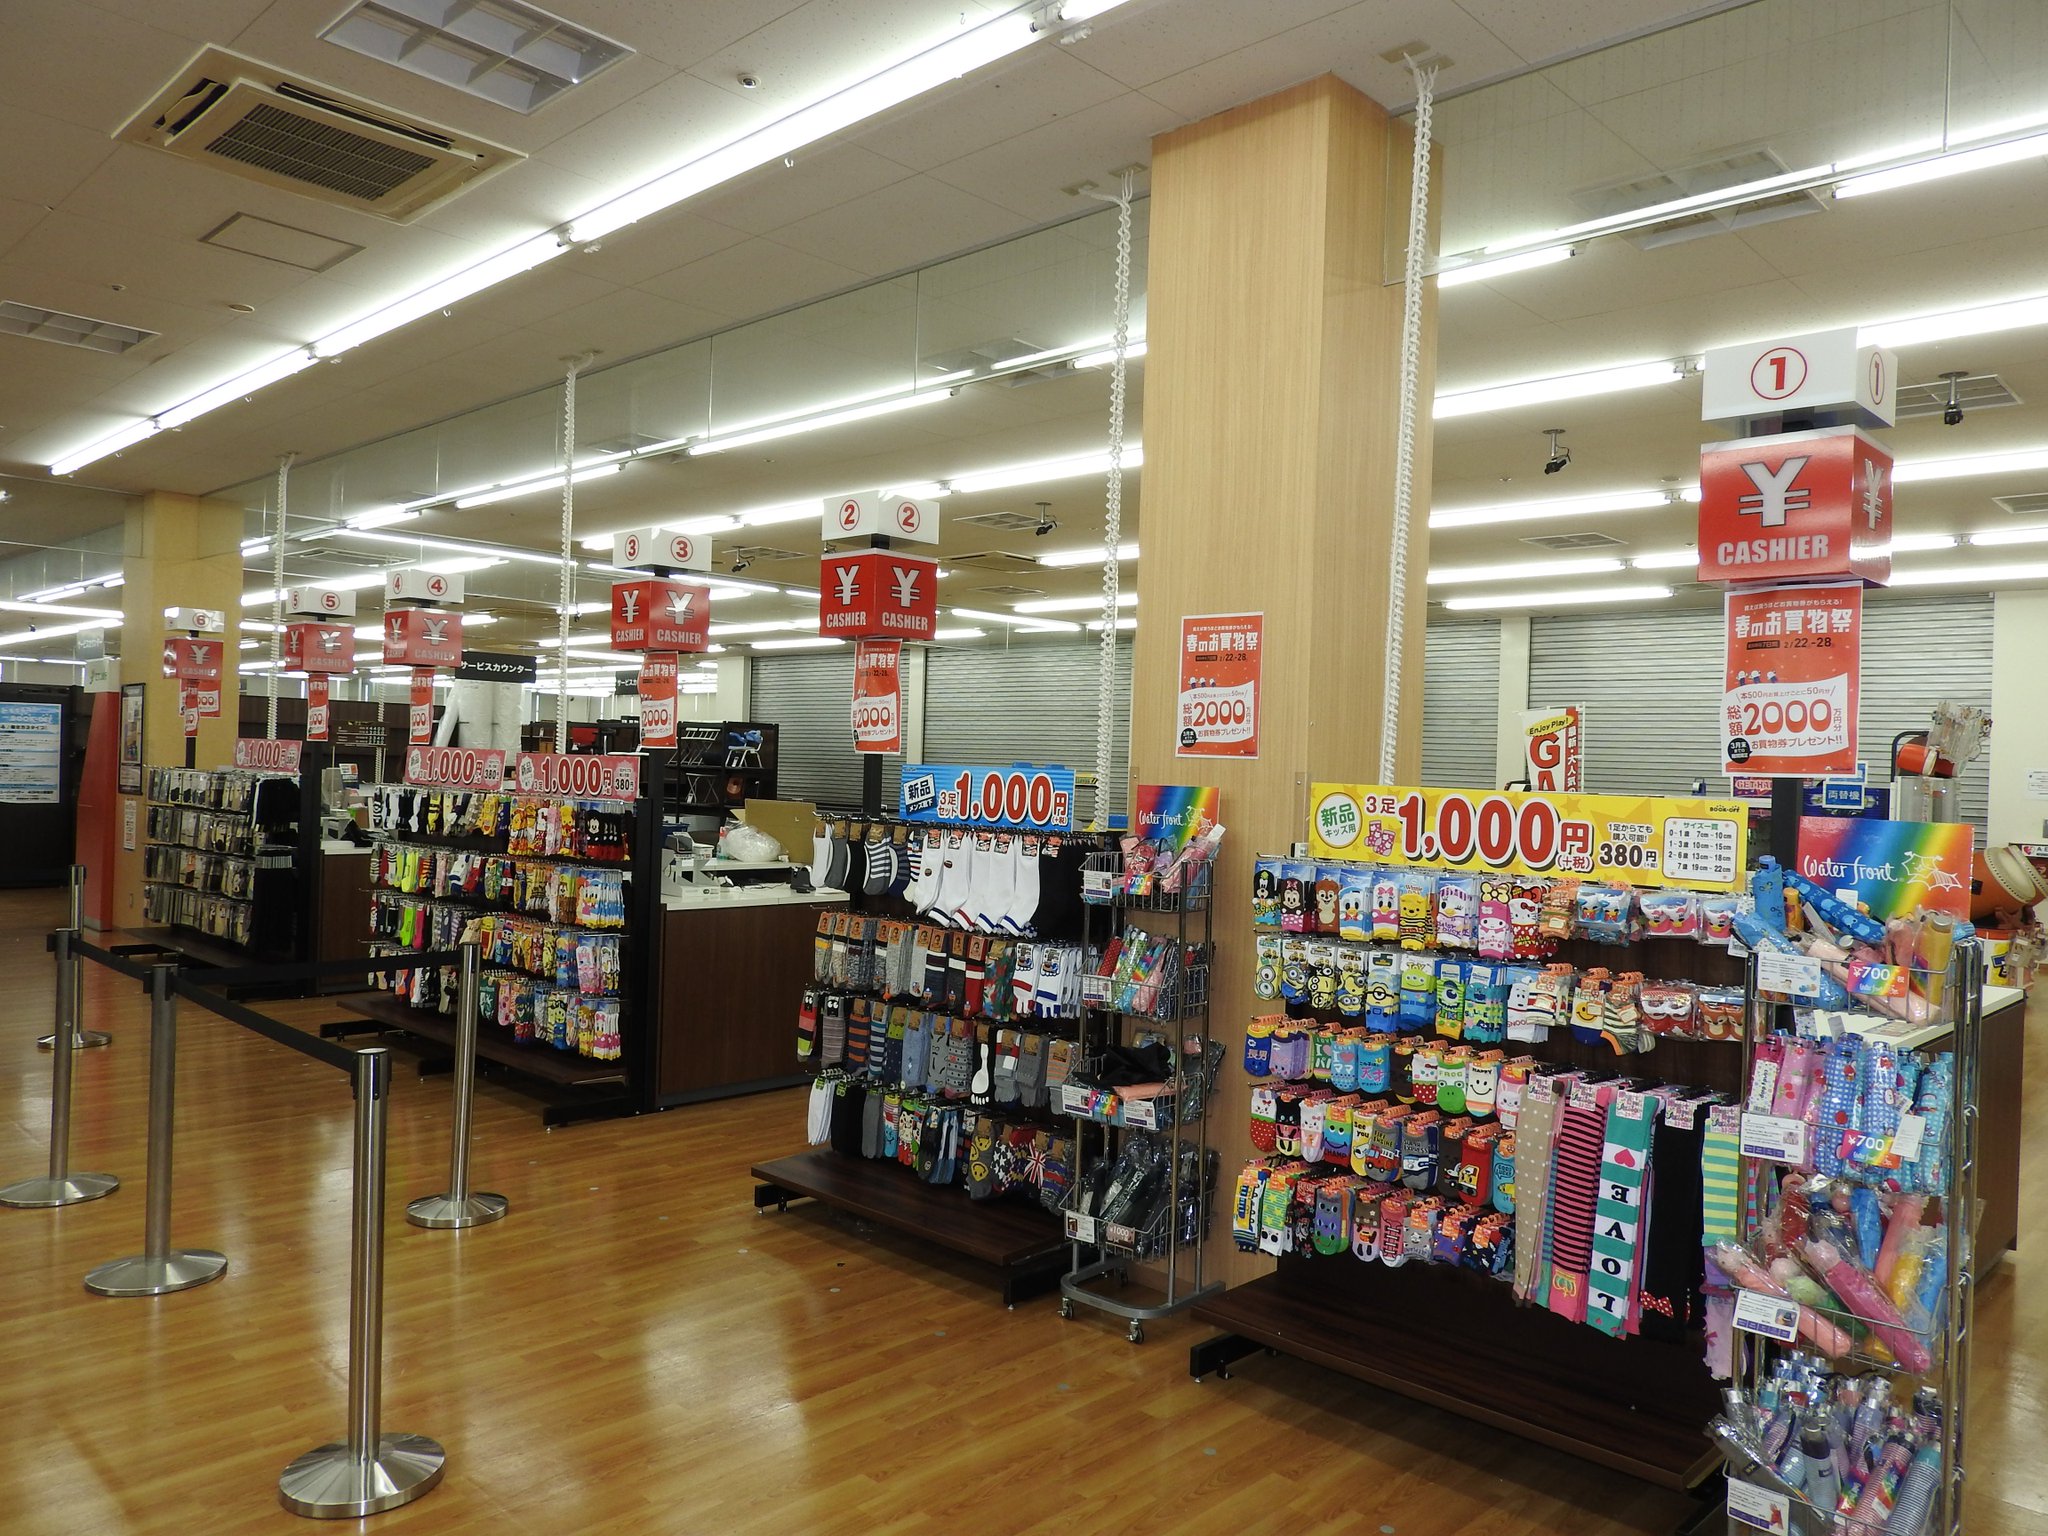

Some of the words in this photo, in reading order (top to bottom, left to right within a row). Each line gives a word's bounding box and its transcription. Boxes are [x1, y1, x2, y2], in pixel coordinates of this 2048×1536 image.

[1717, 534, 1829, 566] CASHIER
[826, 611, 867, 629] CASHIER
[882, 611, 928, 631] CASHIER
[1735, 608, 1853, 639] 春のお買物祭
[616, 628, 644, 643] CASHIER
[656, 629, 701, 645] CASHIER
[1186, 631, 1258, 652] 春のお買物祭
[461, 660, 533, 674] サービスカウンター
[857, 706, 890, 729] 2000
[1193, 699, 1245, 727] 2000
[1743, 699, 1832, 736] 2000
[1529, 724, 1551, 735] Enjoy
[908, 779, 931, 801] 新品
[940, 791, 957, 806] 3足
[1828, 789, 1860, 801] 両替機
[938, 806, 957, 818] セット
[1366, 795, 1395, 814] 3足
[1139, 809, 1161, 826] Water
[1320, 803, 1356, 829] 新品
[1325, 823, 1356, 838] キッズ用
[1608, 823, 1653, 834] 1足からでも
[1804, 854, 1848, 878] Water
[1850, 855, 1898, 885] front
[1853, 965, 1890, 981] ¥700
[1333, 1063, 1354, 1074] ママ
[1361, 1066, 1385, 1083] 天才
[1439, 1070, 1463, 1078] FROG
[1472, 1067, 1493, 1075] HAPPY
[1357, 1129, 1370, 1139] you
[1848, 1134, 1885, 1151] ¥700
